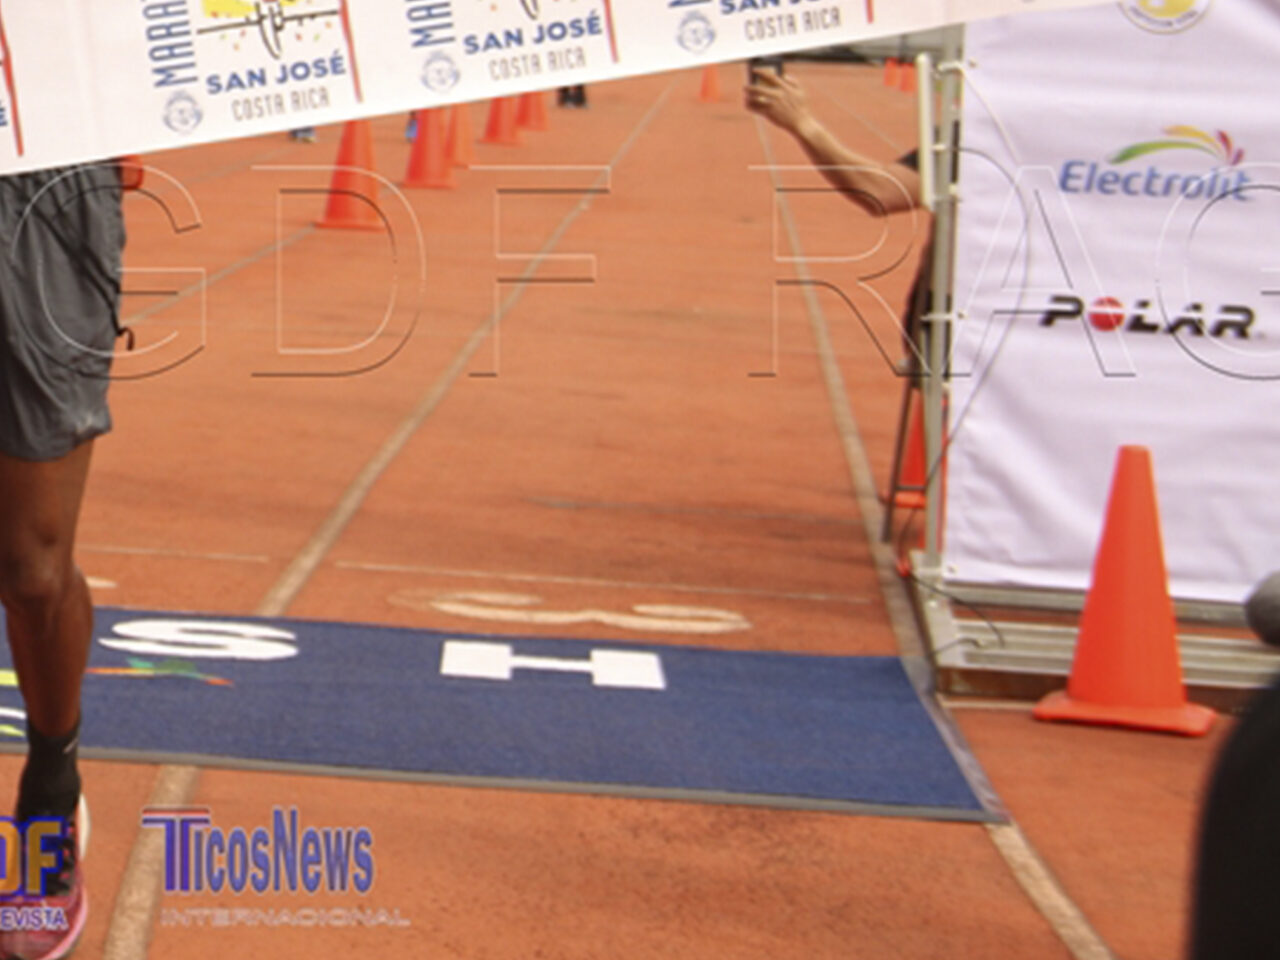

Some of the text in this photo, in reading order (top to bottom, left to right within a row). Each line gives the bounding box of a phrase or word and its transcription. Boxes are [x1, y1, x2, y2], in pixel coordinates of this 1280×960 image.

[463, 9, 602, 54] SAN JOSÉ
[744, 6, 841, 41] COSTA RICA
[206, 49, 346, 94] SAN JOSÉ
[488, 46, 586, 81] COSTA RICA
[231, 86, 330, 121] COSTA RICA
[1039, 295, 1255, 340] POLAR
